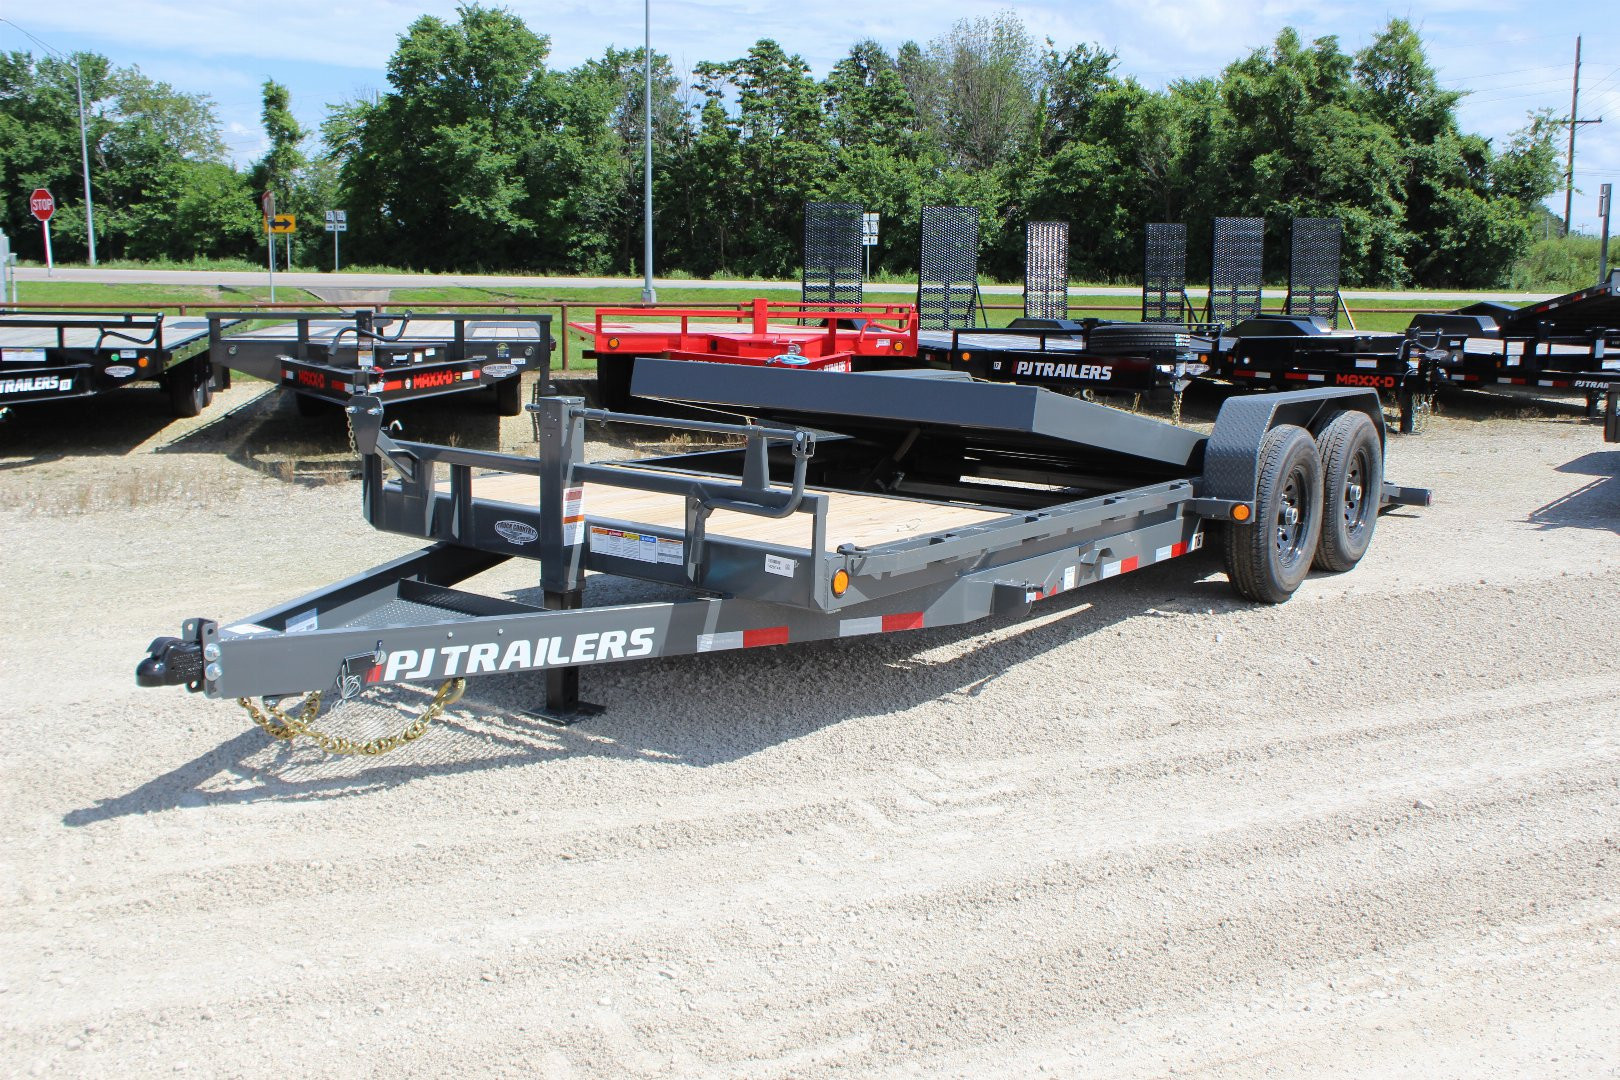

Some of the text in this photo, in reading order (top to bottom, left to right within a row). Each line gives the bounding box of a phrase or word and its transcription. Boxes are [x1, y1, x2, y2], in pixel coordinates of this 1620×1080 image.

[32, 199, 52, 210] STOP
[413, 369, 453, 389] MAXX-D
[1016, 361, 1113, 381] PJ TRAILERS
[1336, 374, 1395, 388] MAXX-D
[383, 627, 655, 682] PJ TRAILERS
